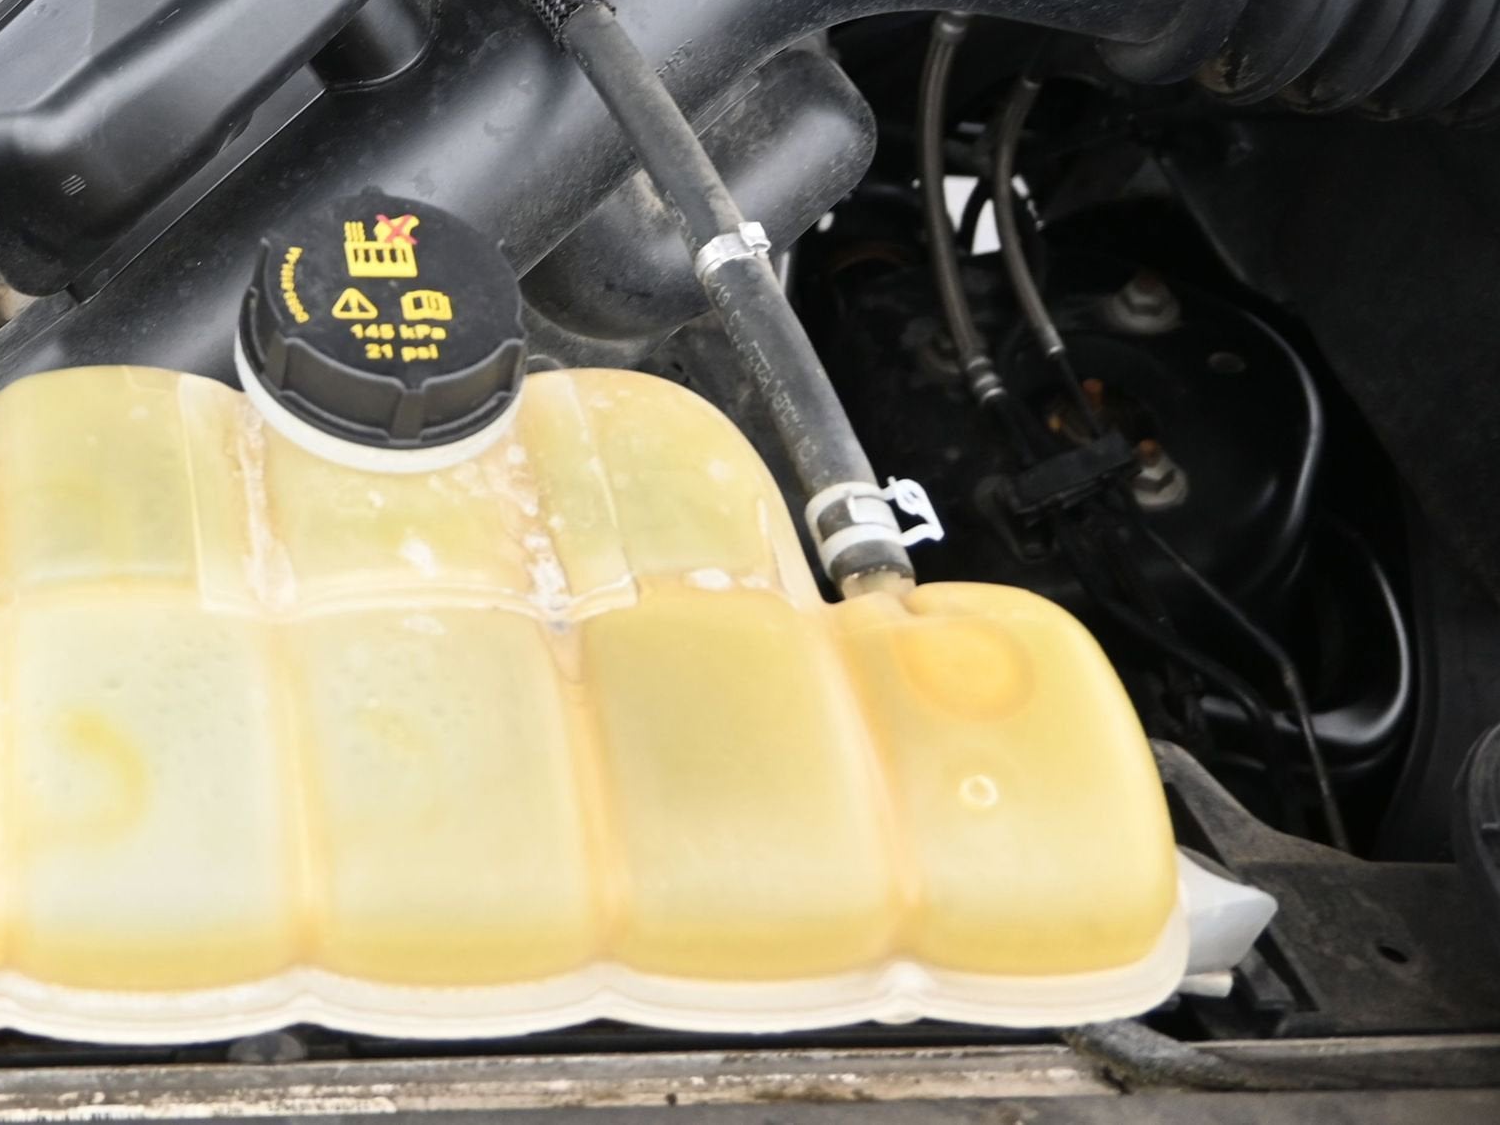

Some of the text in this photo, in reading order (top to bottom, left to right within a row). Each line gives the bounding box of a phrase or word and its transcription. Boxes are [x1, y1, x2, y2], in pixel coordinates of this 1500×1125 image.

[350, 322, 446, 341] 145 kPa
[365, 342, 441, 363] 21 psi
